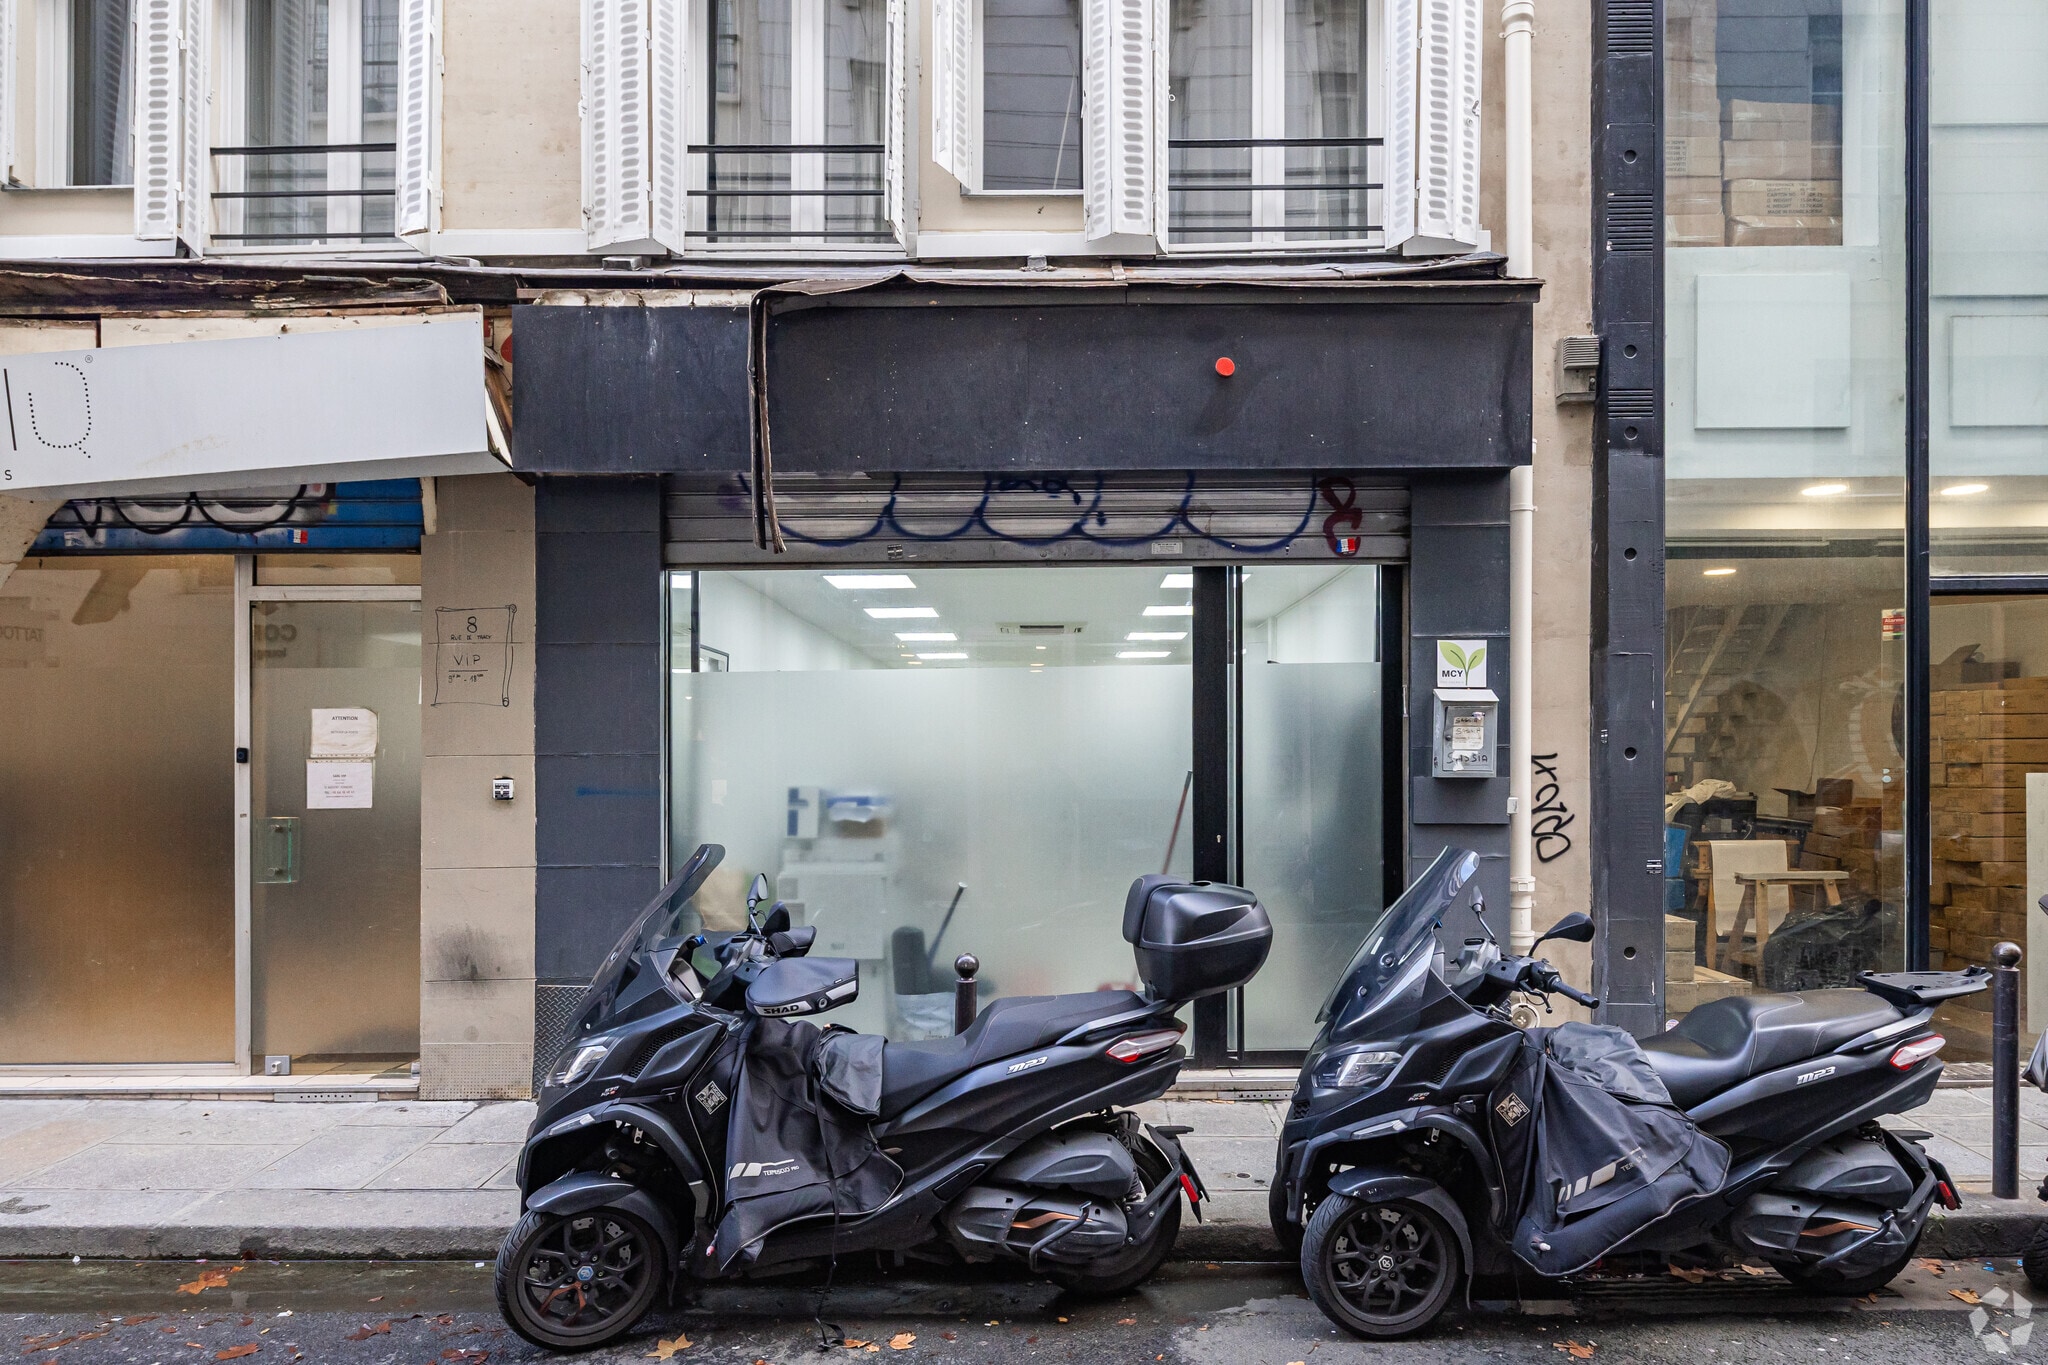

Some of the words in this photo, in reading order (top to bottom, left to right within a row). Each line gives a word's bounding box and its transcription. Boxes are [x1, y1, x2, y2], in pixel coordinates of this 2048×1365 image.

[466, 616, 478, 633] 8
[1441, 670, 1464, 678] MCY
[763, 1004, 800, 1015] SHAD
[1006, 1056, 1048, 1075] MP3
[1796, 1066, 1836, 1085] MP3
